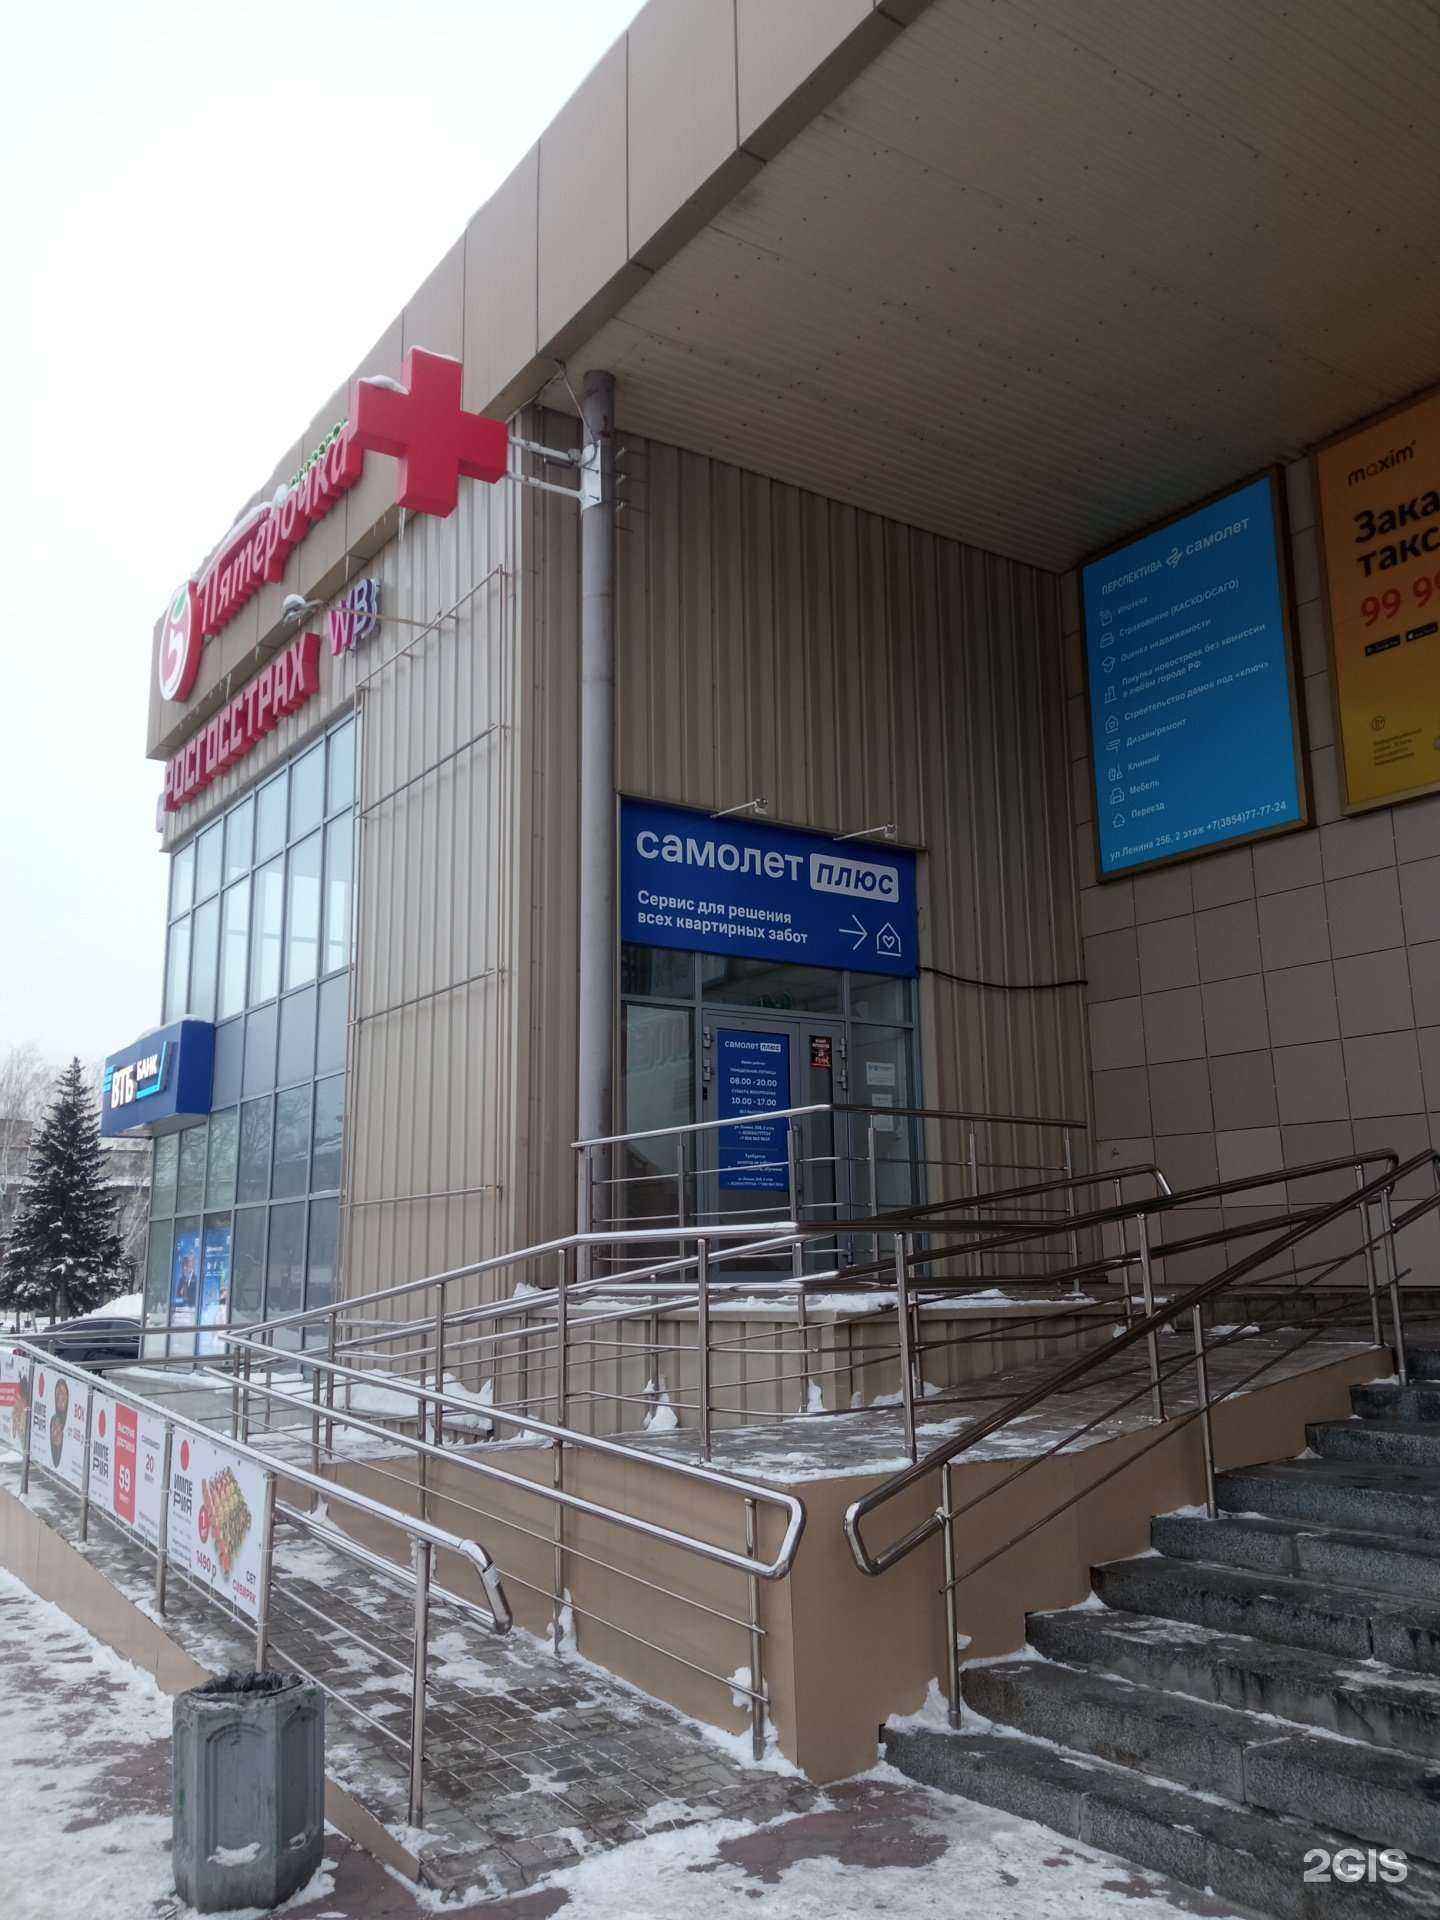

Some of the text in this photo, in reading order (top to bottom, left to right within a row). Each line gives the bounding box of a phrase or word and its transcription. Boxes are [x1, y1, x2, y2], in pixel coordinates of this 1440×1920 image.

[1347, 444, 1414, 487] maxim
[1102, 517, 1249, 596] ПЕРСПЕКТИВА самолет
[328, 578, 378, 657] WB
[1361, 587, 1401, 627] 99
[165, 636, 312, 805] РОСГОССТРАХ
[635, 830, 894, 896] самолет плюс
[637, 890, 792, 924] Сервис для решения
[637, 911, 808, 944] всех квартирных забот
[111, 1054, 158, 1109] ВТБ БАНК
